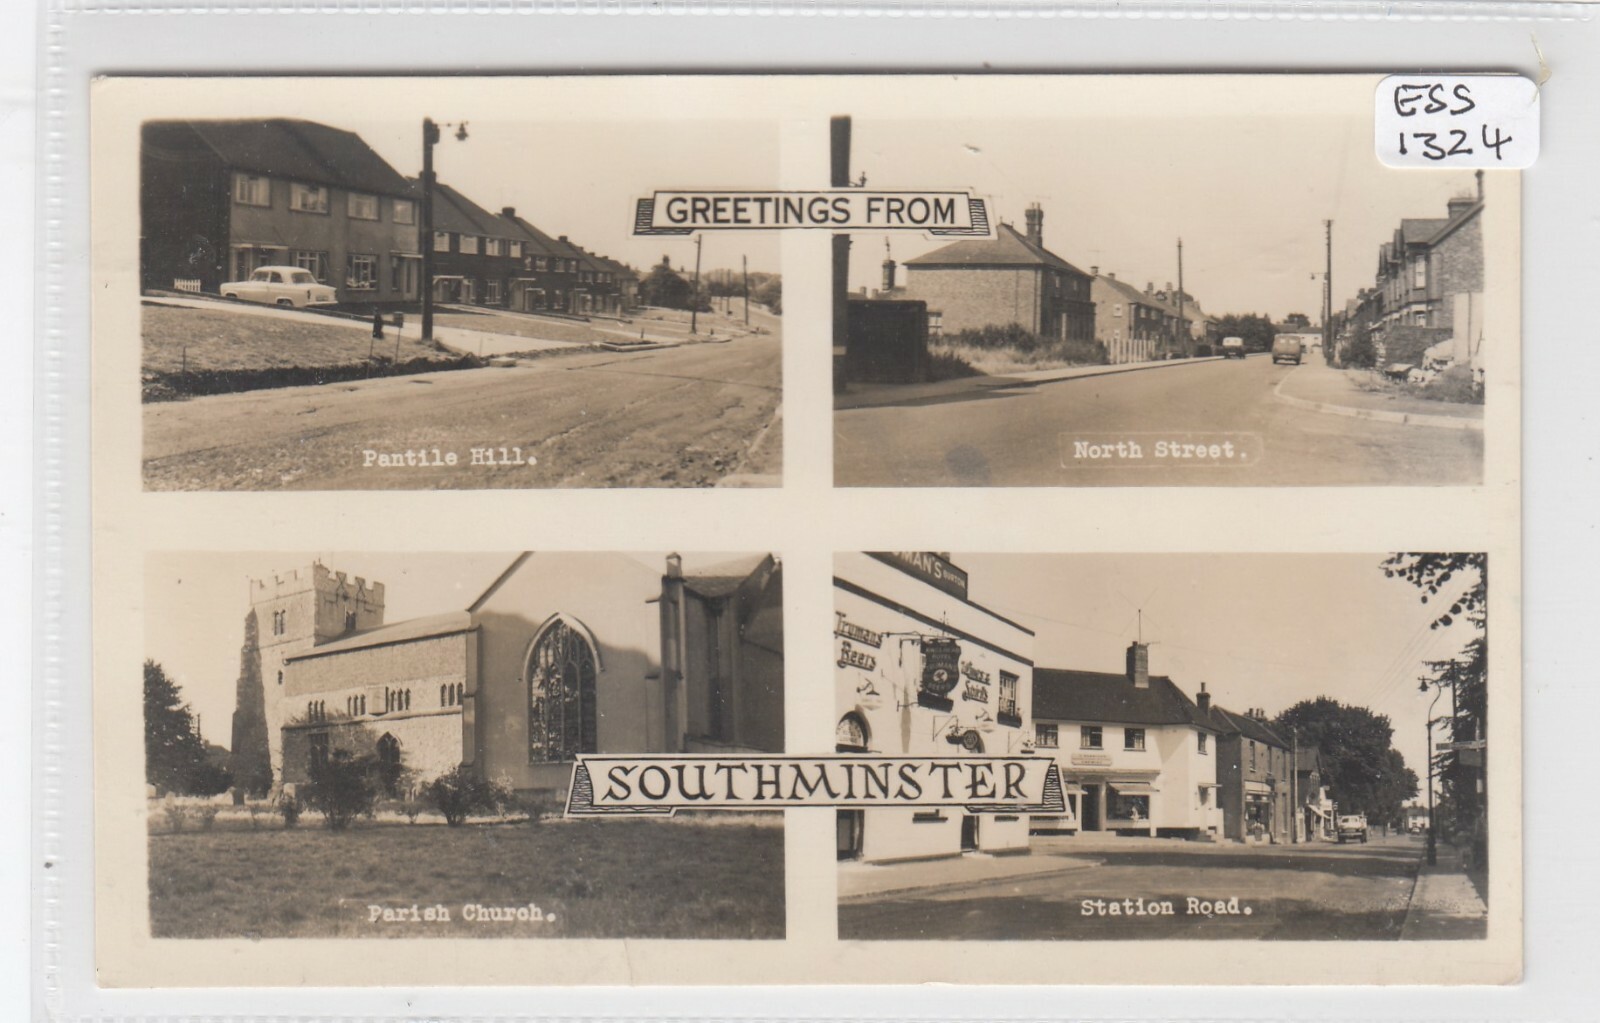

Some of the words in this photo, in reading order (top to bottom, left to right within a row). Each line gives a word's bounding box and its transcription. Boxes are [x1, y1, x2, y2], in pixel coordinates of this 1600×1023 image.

[1394, 83, 1475, 117] ESS
[1399, 123, 1513, 160] 1324
[837, 640, 876, 671] Beers
